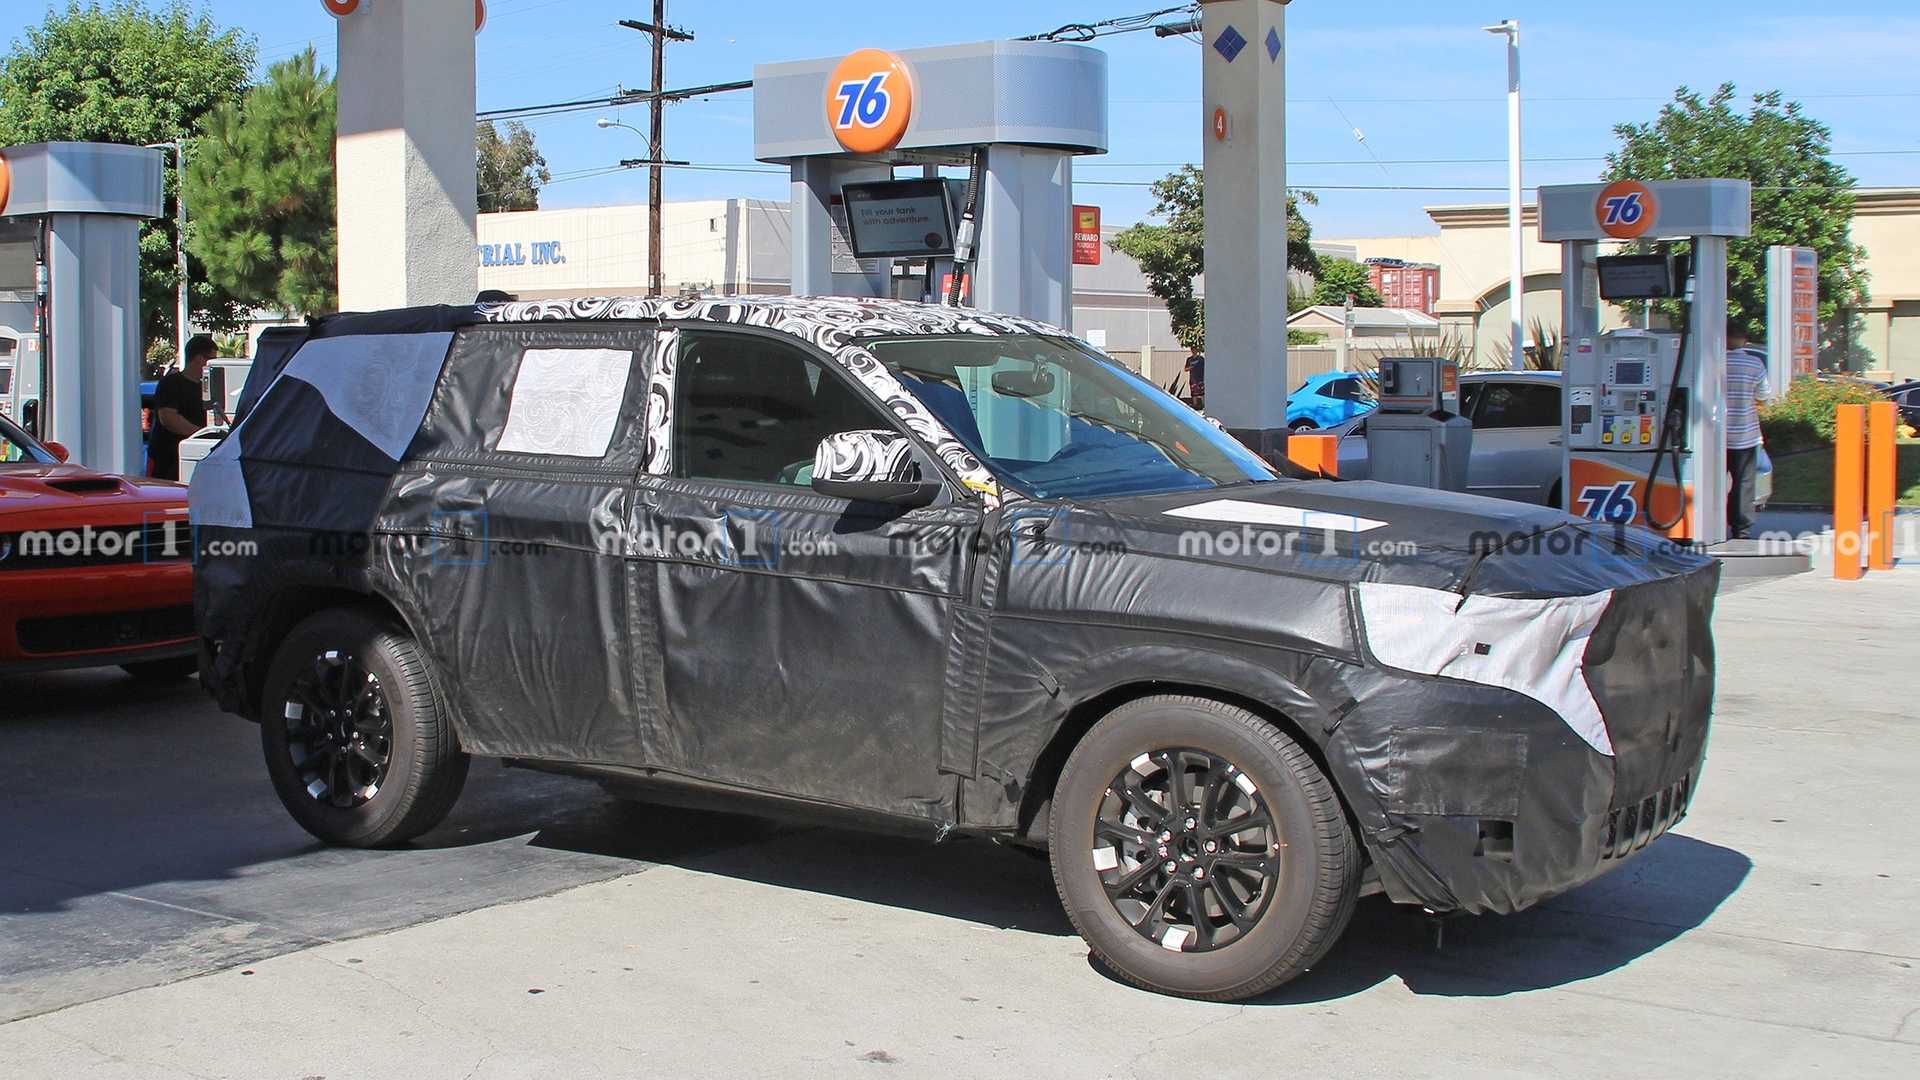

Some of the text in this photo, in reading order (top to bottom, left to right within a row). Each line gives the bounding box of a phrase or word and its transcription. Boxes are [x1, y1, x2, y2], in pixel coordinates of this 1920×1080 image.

[835, 71, 891, 129] 76
[1217, 115, 1224, 133] 4
[1602, 192, 1643, 225] 76
[1074, 232, 1098, 242] REWARD
[531, 241, 566, 264] INC.
[1577, 481, 1637, 525] 76
